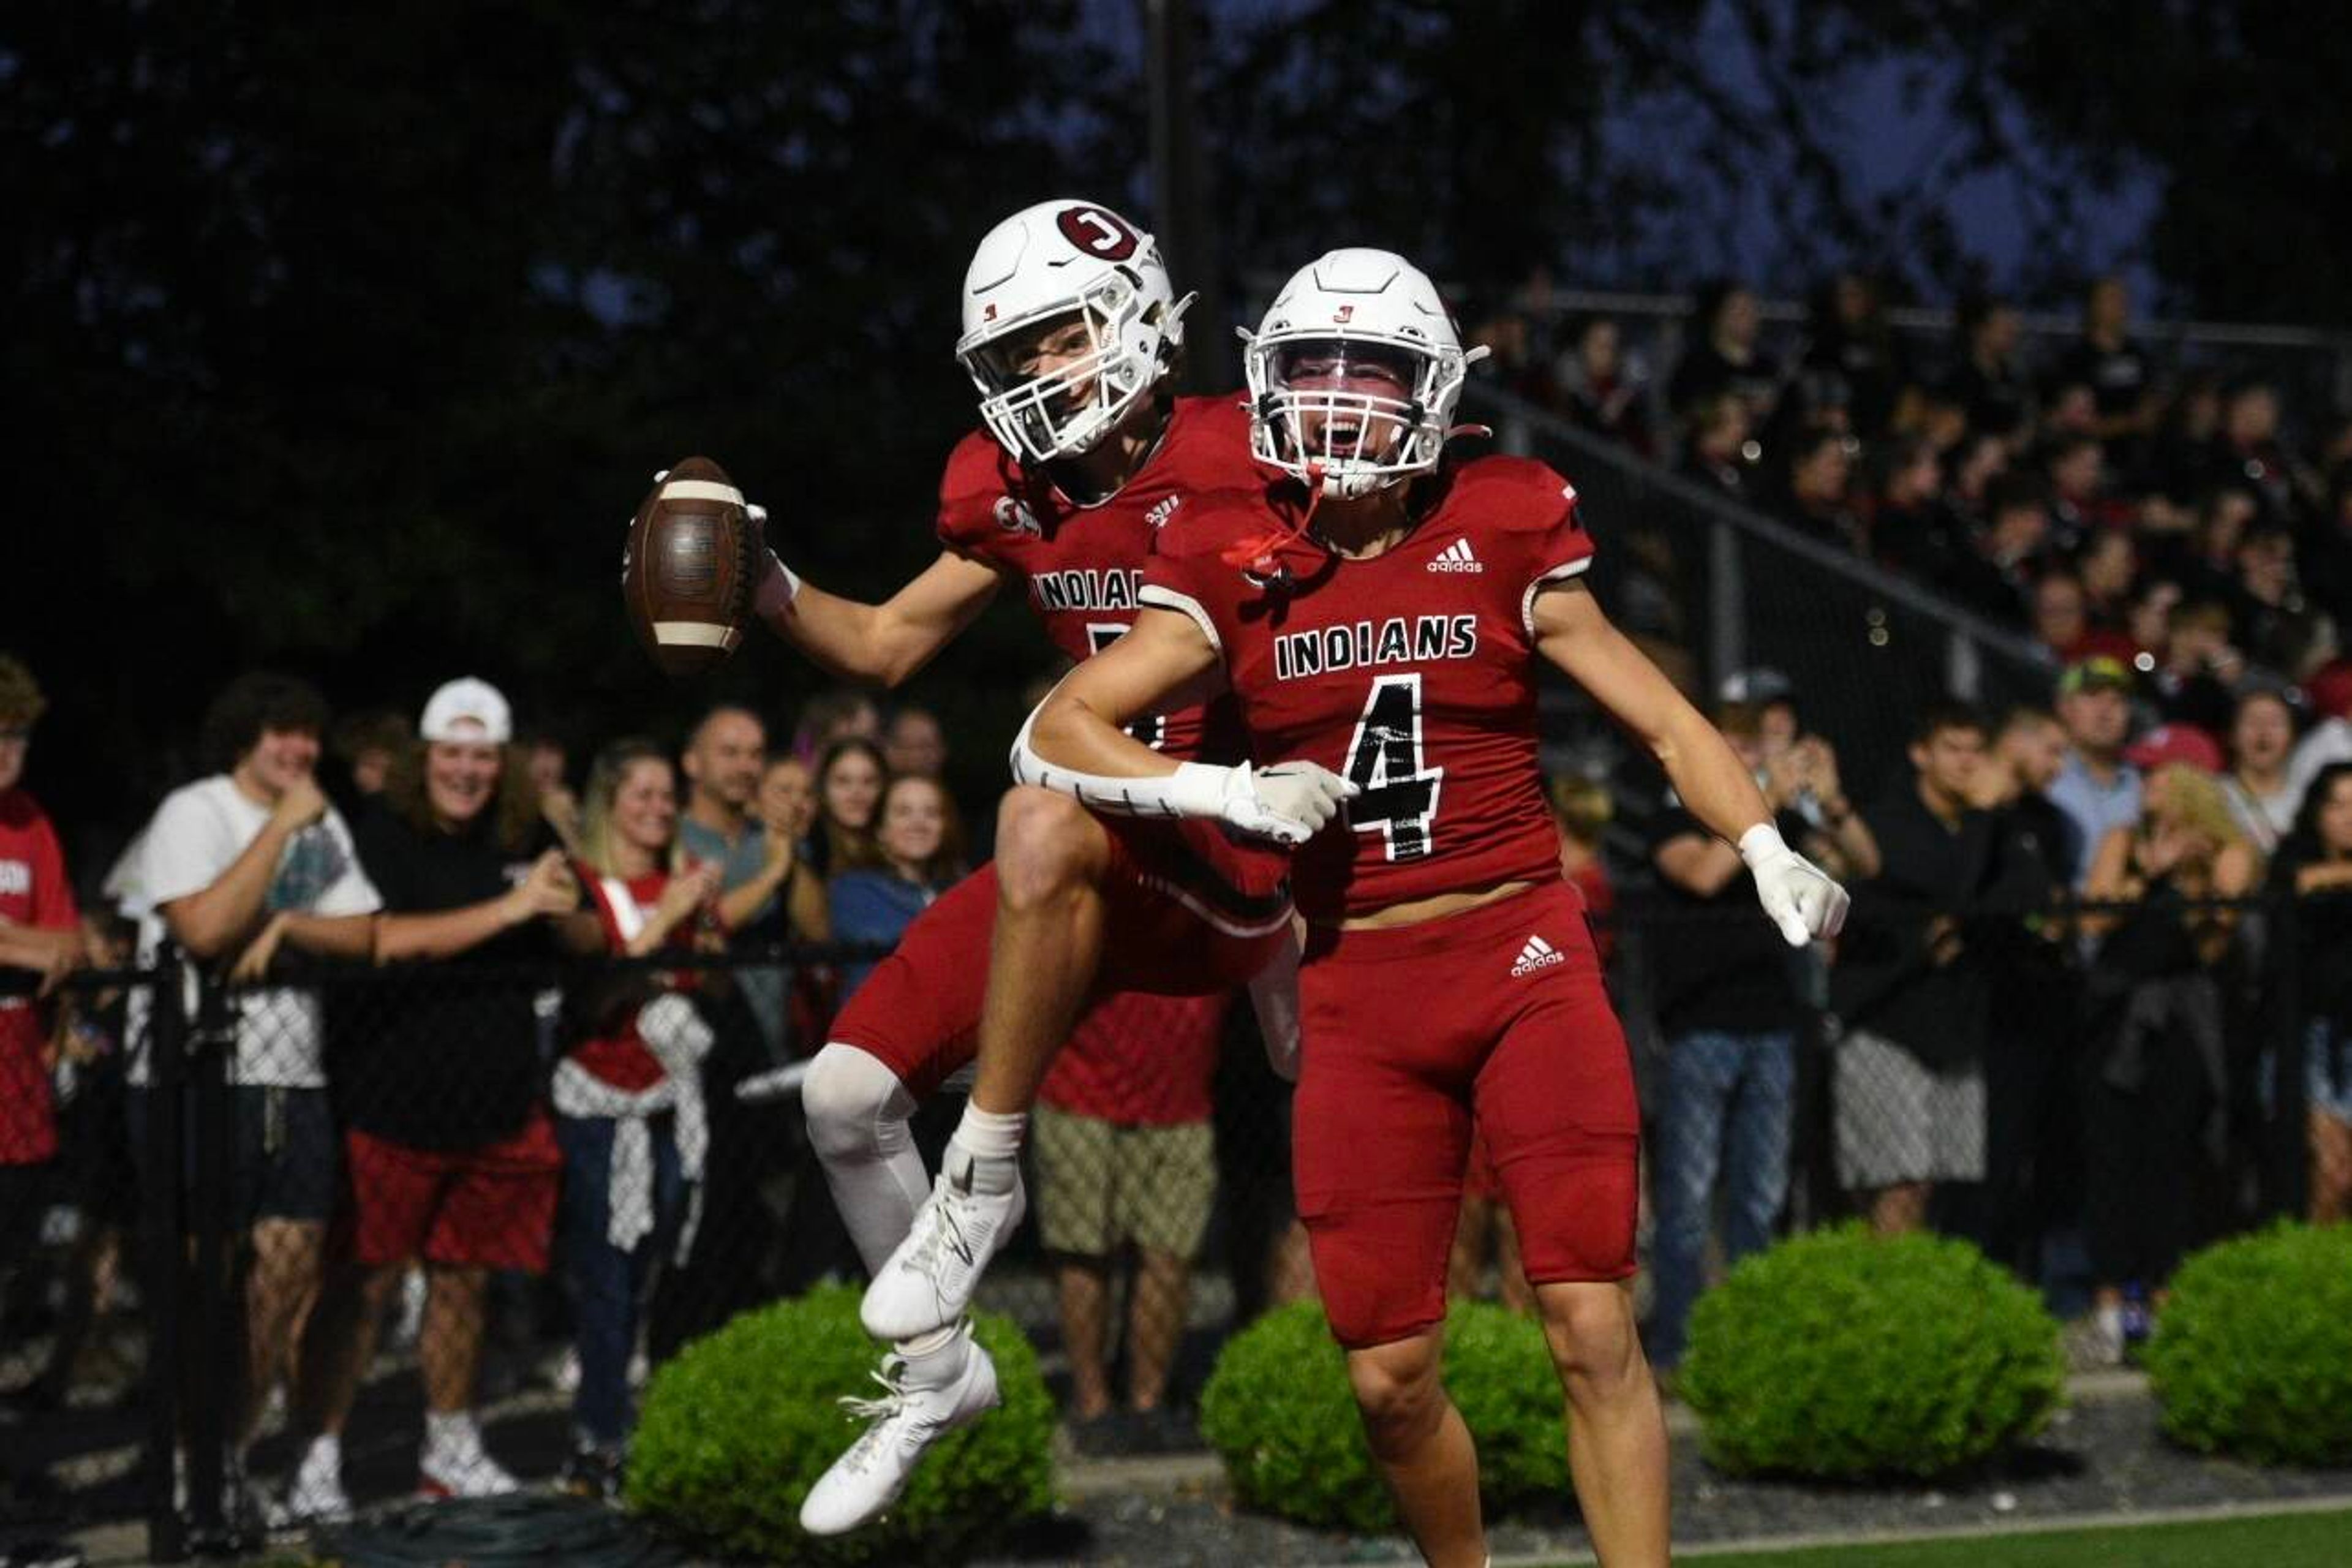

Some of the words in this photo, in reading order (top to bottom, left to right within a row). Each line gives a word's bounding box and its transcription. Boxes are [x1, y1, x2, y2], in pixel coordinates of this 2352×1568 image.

[1077, 211, 1122, 251] J
[1427, 559, 1483, 573] adidas
[1275, 615, 1477, 680] INDIANS
[1341, 673, 1444, 861] 4
[1511, 952, 1564, 978] adidas
